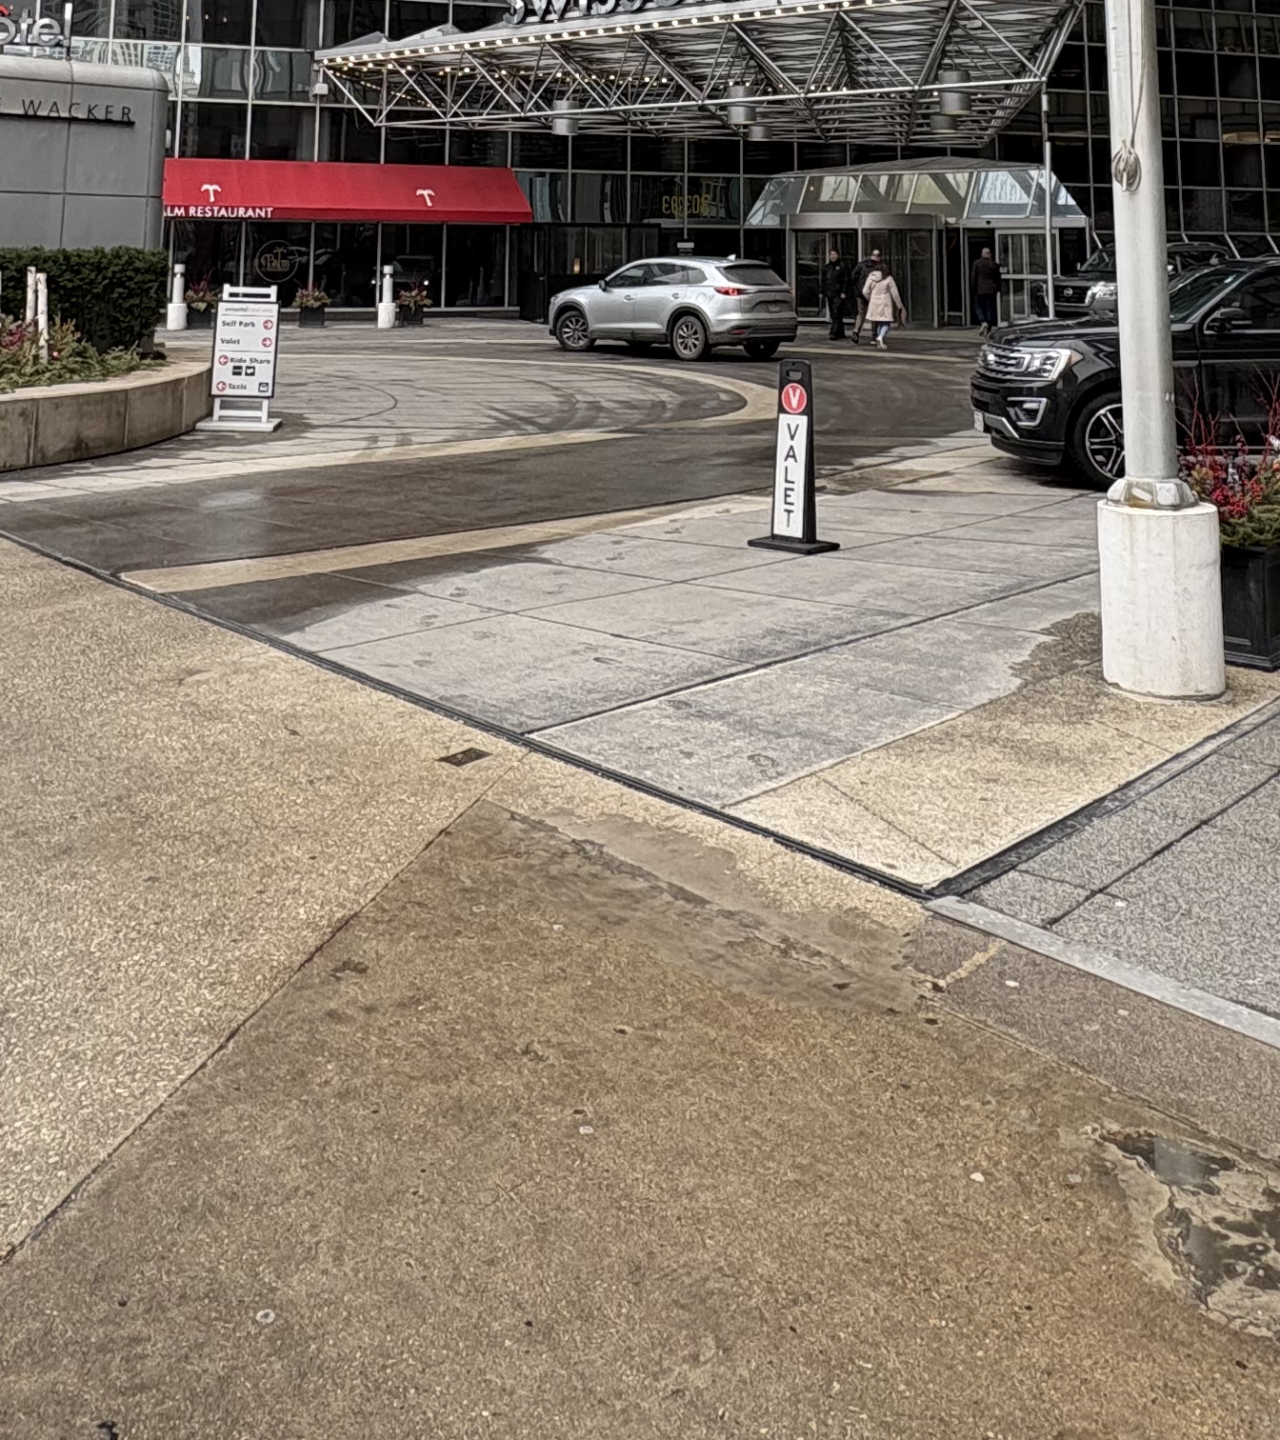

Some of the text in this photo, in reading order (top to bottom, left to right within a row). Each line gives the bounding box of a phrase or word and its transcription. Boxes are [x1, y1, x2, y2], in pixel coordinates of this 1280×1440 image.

[22, 99, 133, 121] WACKER
[188, 206, 274, 218] RESTAURANT
[239, 320, 256, 328] Park
[788, 387, 801, 409] V
[783, 423, 800, 528] VALET
